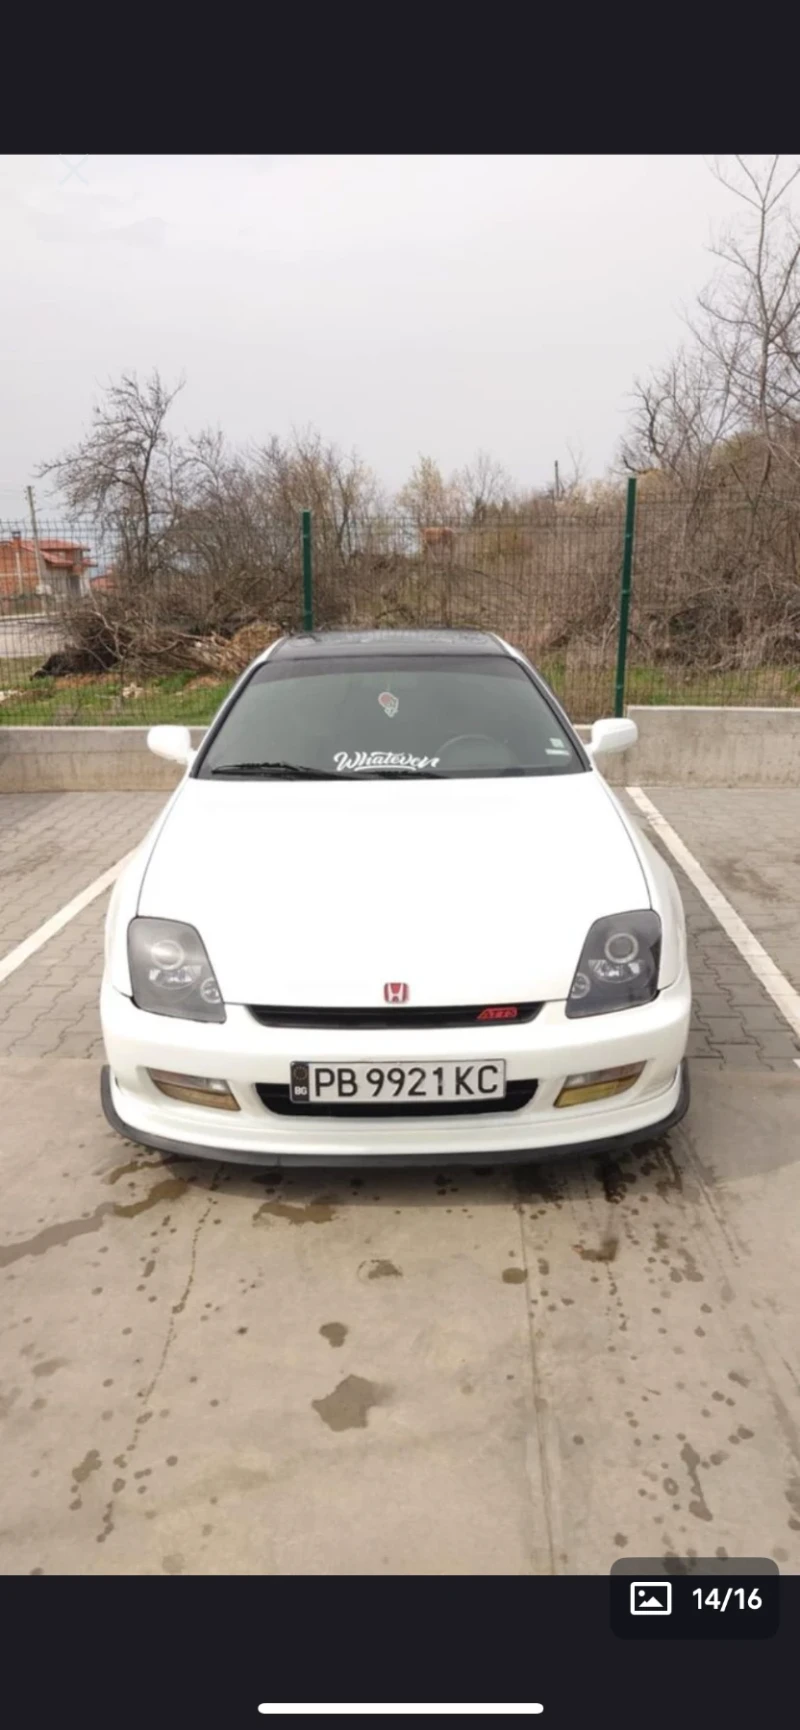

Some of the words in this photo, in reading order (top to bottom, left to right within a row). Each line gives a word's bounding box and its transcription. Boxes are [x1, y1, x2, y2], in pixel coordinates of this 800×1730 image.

[333, 751, 440, 771] Whatever
[294, 1086, 307, 1095] BG
[315, 1068, 358, 1097] PB
[366, 1067, 443, 1097] 9921
[455, 1065, 498, 1096] KC
